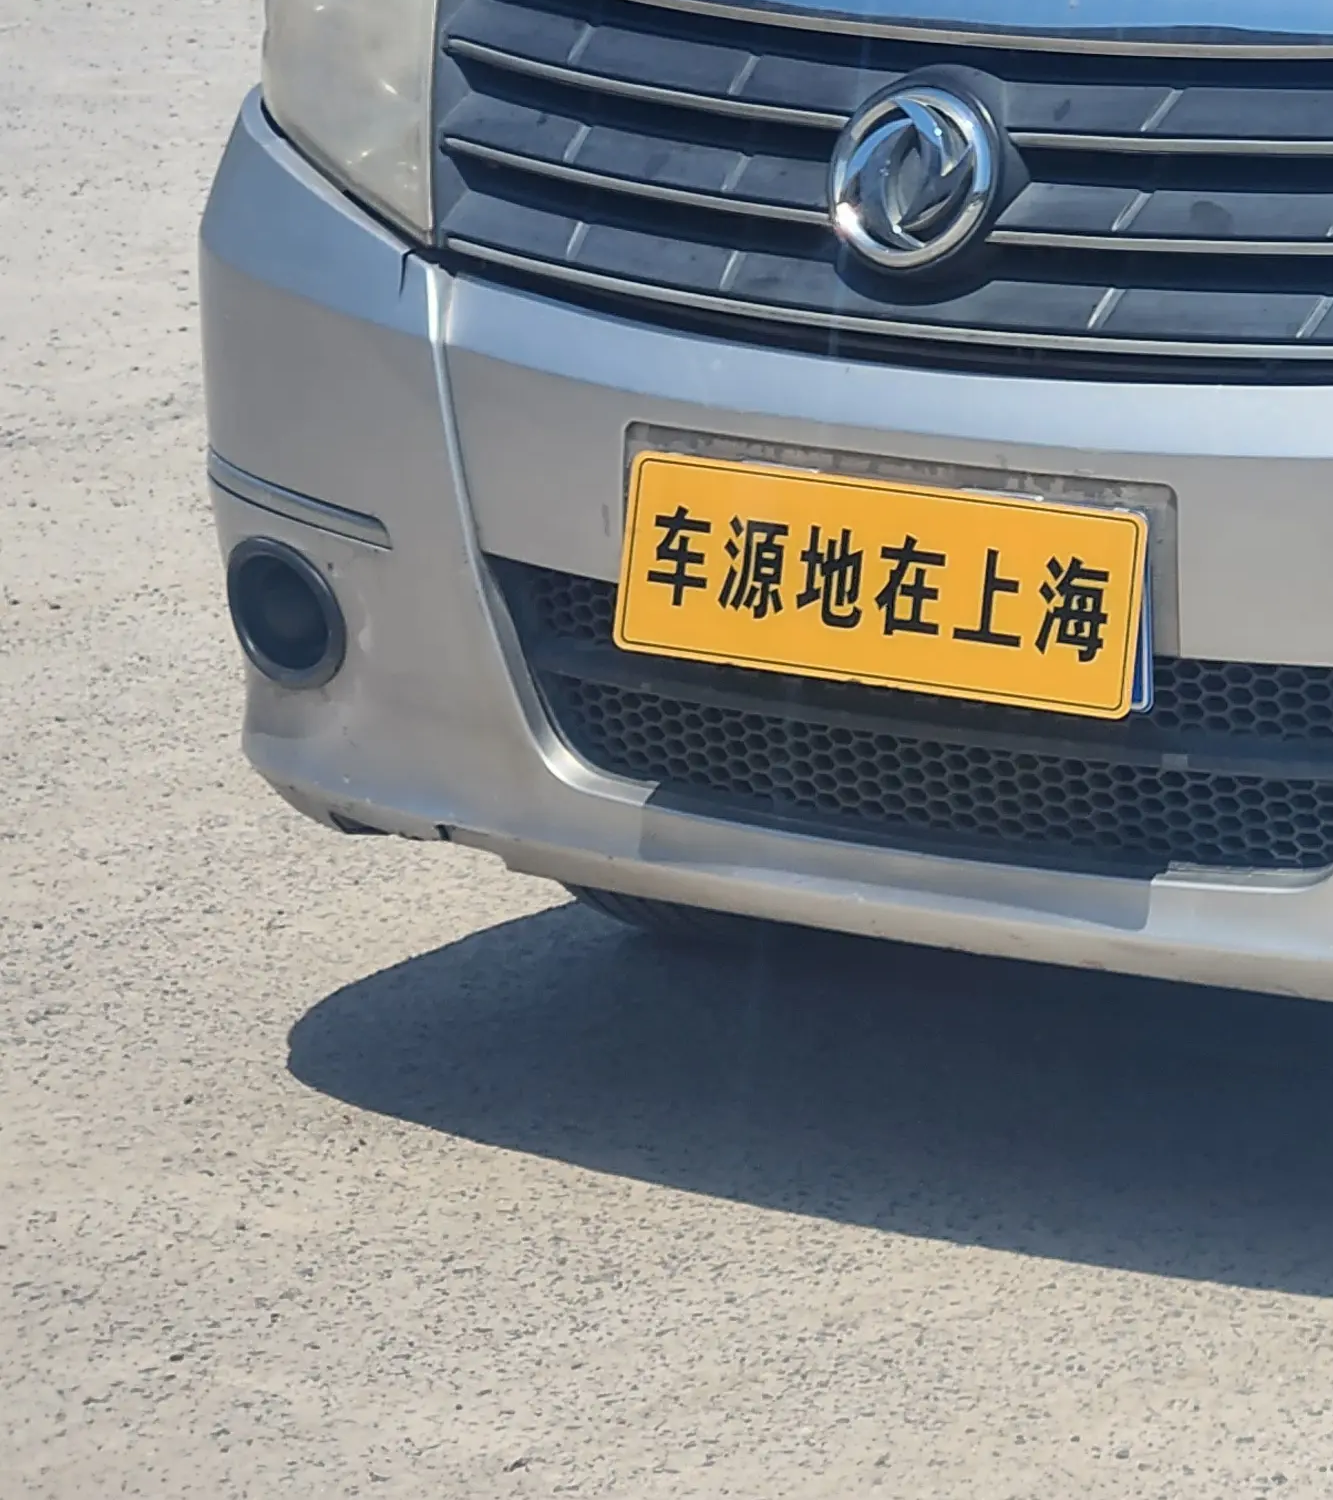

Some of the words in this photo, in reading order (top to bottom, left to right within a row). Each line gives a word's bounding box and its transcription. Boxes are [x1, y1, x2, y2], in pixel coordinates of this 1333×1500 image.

[646, 505, 1110, 663] 车源地在上海
